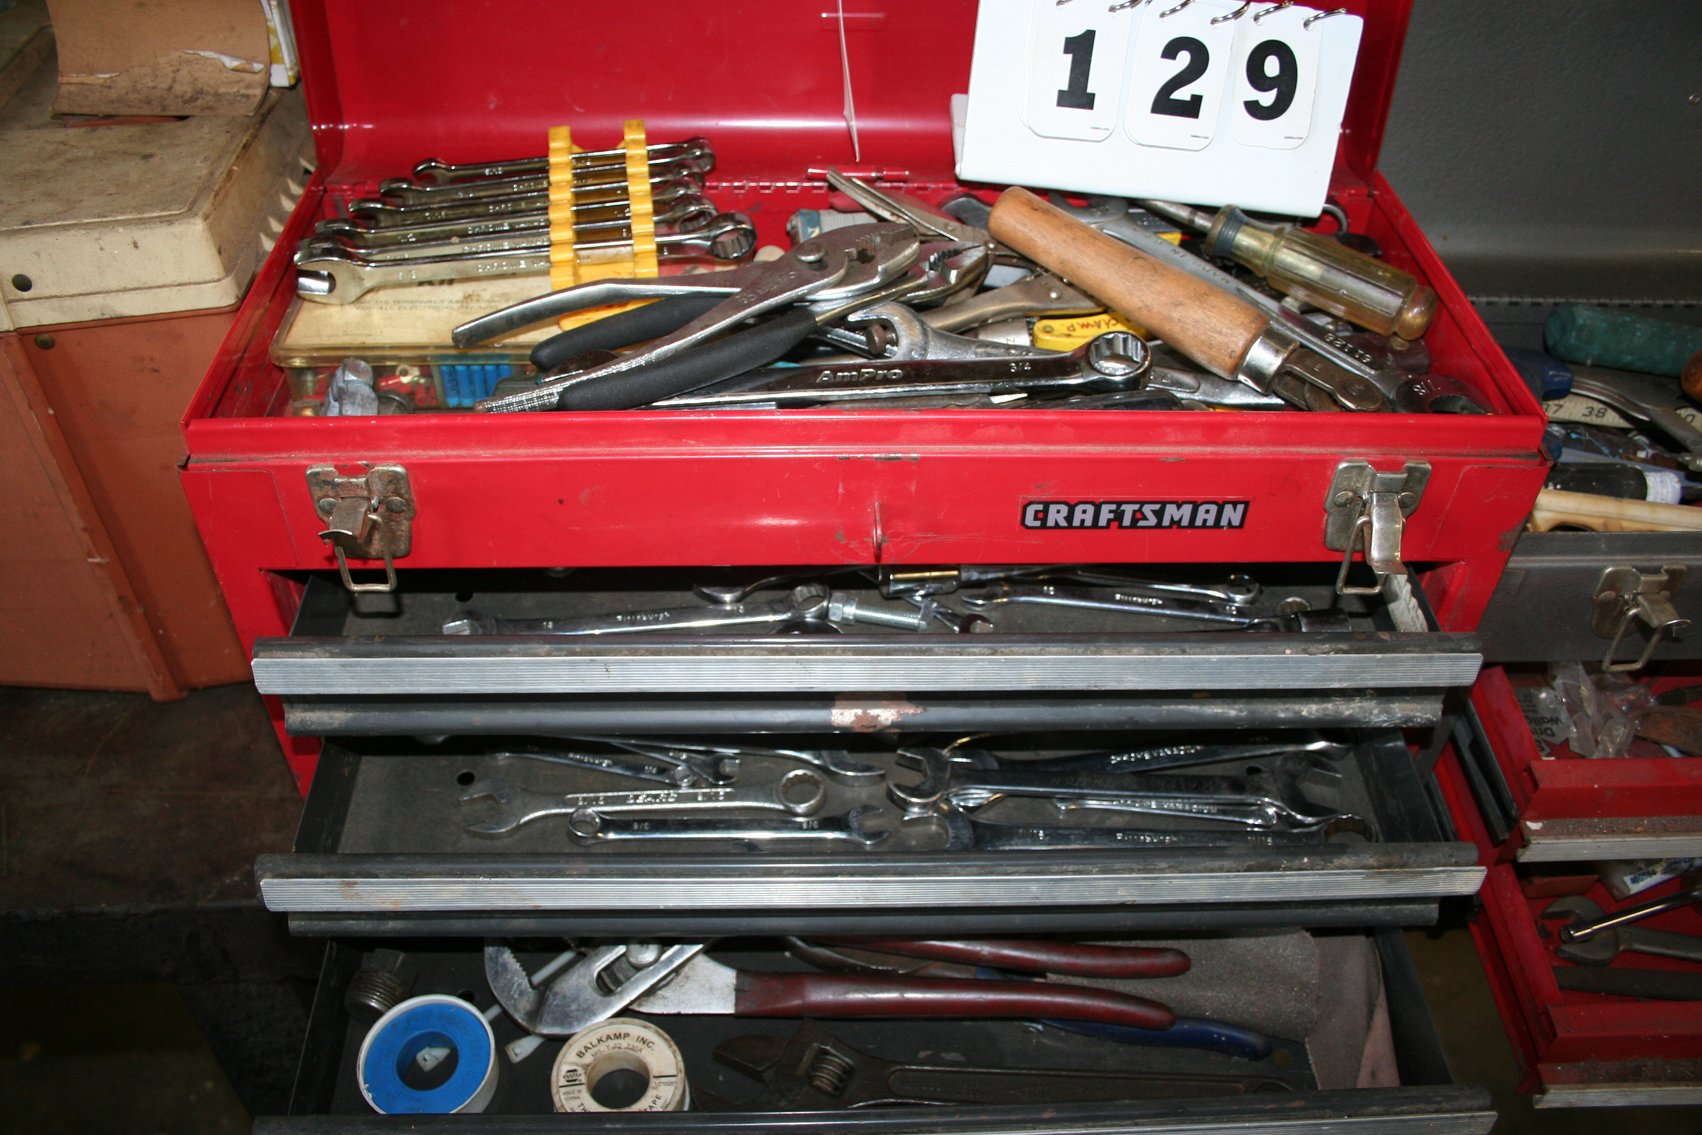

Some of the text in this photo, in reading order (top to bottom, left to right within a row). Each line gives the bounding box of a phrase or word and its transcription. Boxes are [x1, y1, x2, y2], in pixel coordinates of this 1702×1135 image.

[815, 368, 904, 384] AmPro
[1582, 406, 1608, 419] 38
[1023, 502, 1247, 528] CRAFTSMAN
[575, 1032, 631, 1059] BALKAMP
